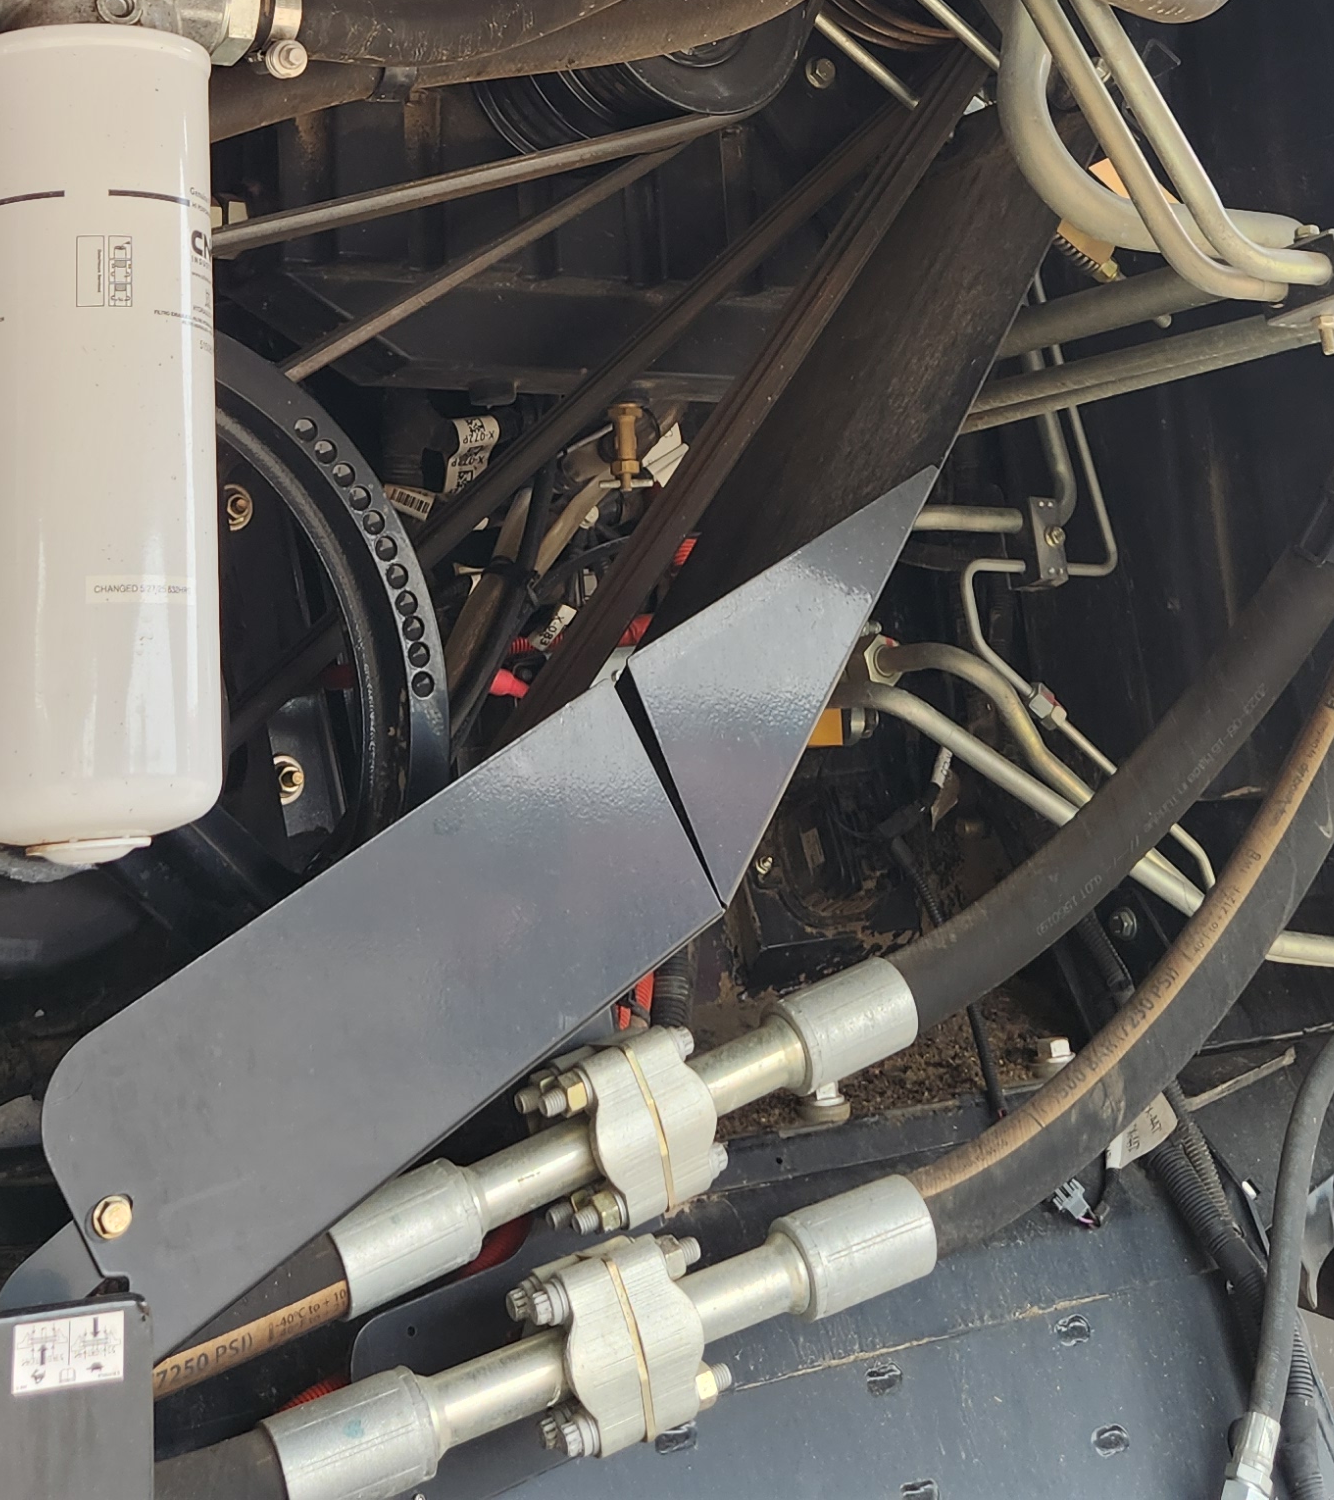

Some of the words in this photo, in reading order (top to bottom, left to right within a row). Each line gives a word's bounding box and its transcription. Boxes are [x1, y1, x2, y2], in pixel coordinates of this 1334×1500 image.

[191, 230, 211, 260] CN
[93, 584, 138, 593] CHANGED
[152, 1352, 209, 1389] 7250
[213, 1332, 254, 1363] PSI)
[332, 1287, 348, 1301] 10
